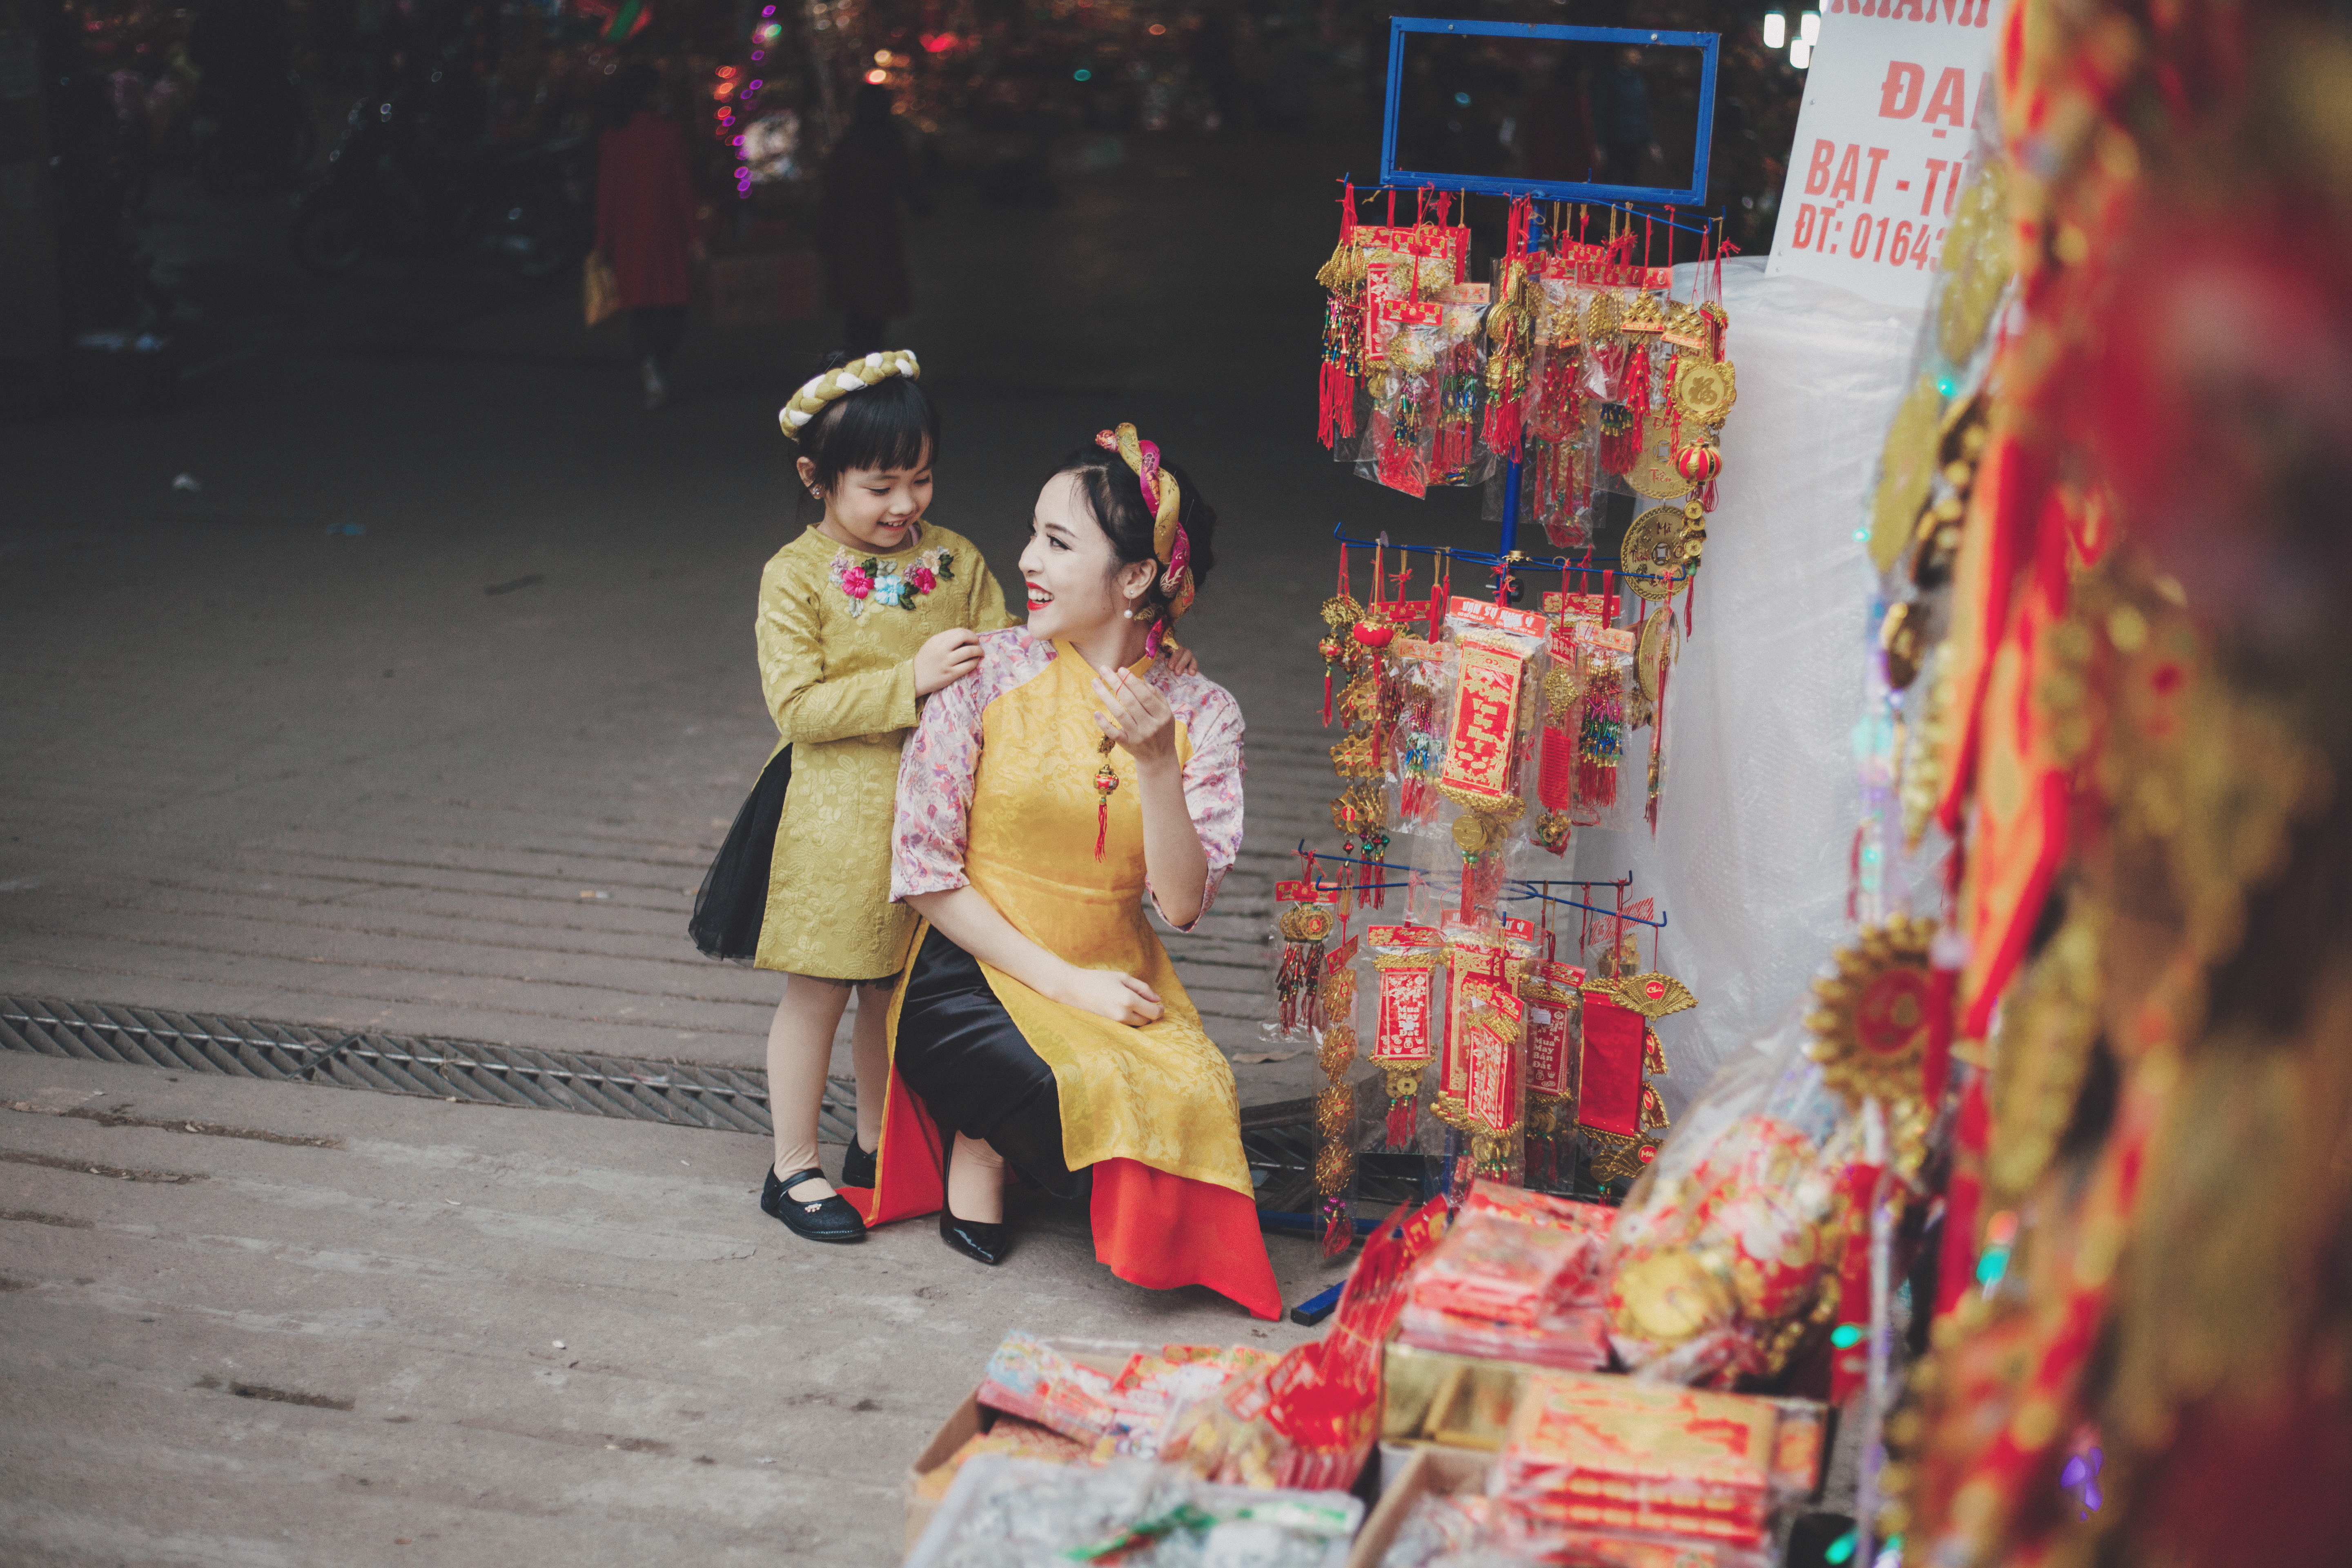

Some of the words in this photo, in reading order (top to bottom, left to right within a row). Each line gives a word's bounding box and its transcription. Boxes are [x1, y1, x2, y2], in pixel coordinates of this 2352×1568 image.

[1804, 138, 1890, 209] BẠT
[1792, 203, 1843, 254] ĐT:
[1688, 376, 1717, 405] 福
[1398, 1013, 1419, 1021] May
[1534, 1037, 1555, 1046] Mua
[1533, 1044, 1554, 1054] May
[1533, 1051, 1553, 1061] Bán
